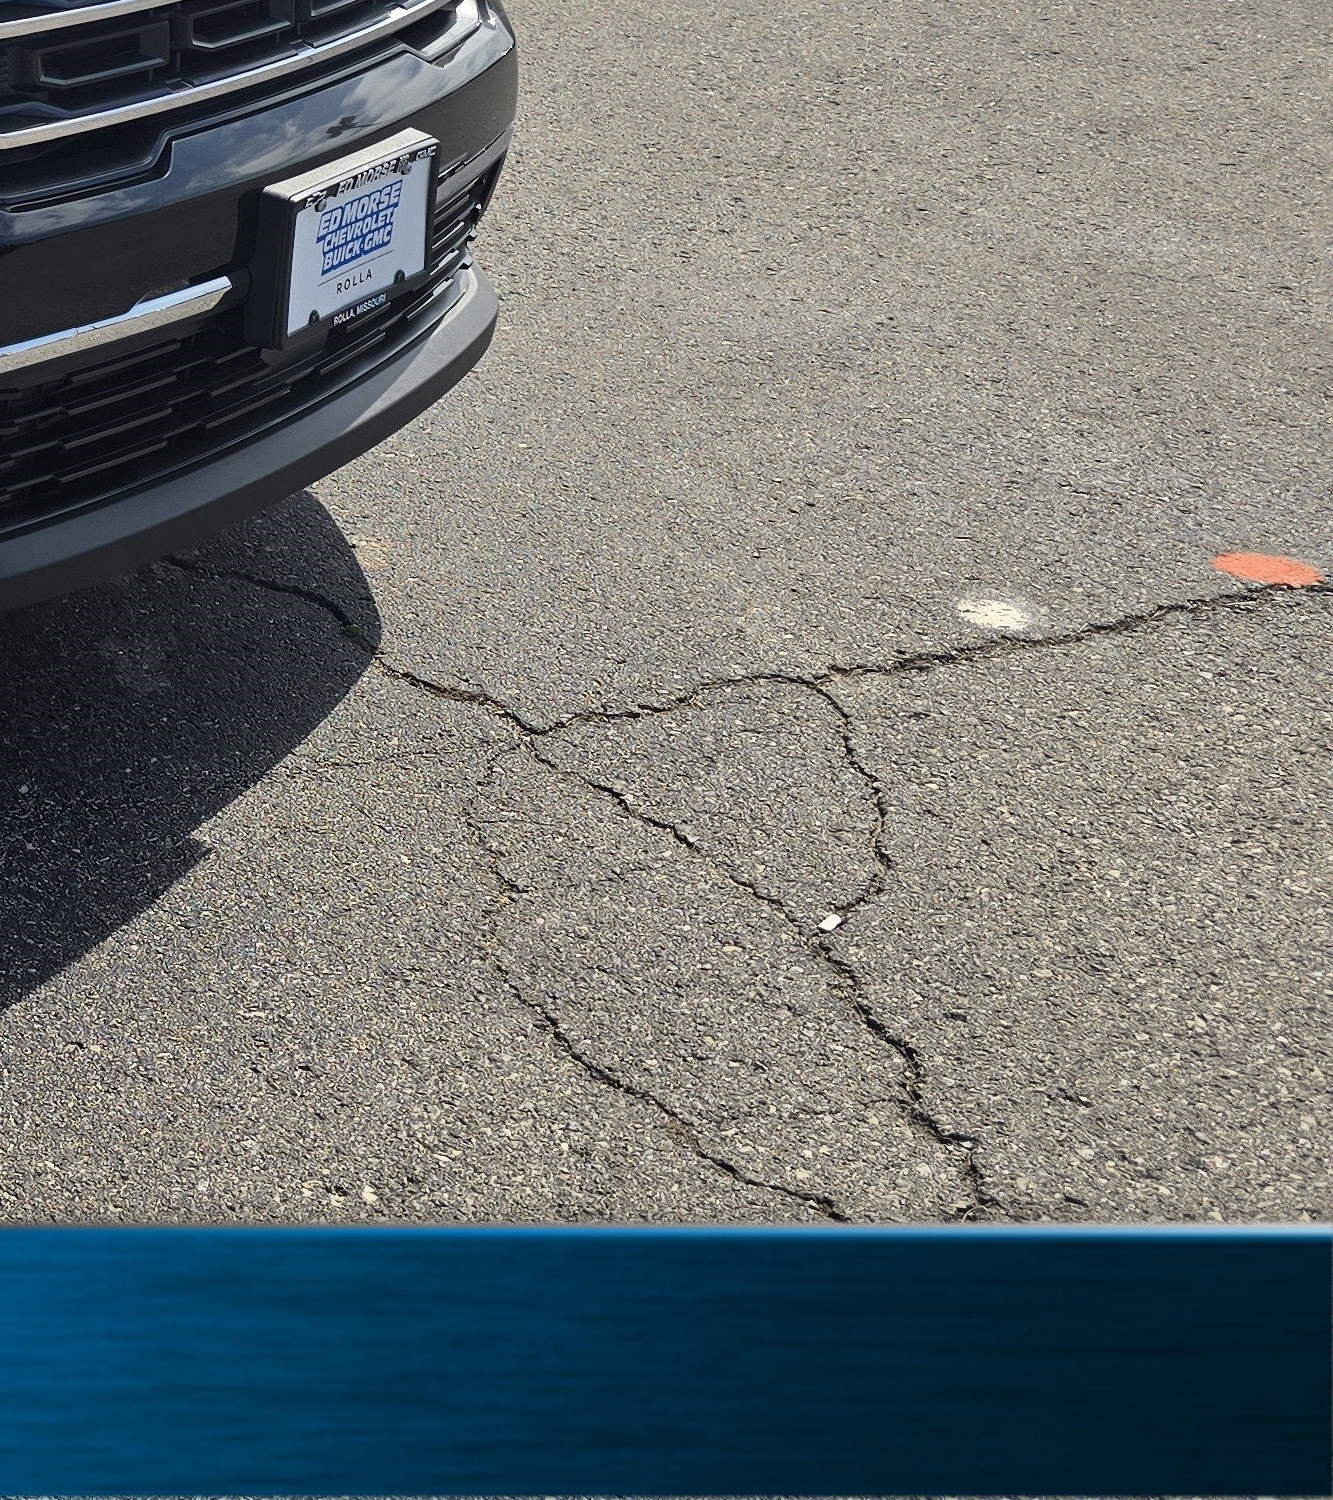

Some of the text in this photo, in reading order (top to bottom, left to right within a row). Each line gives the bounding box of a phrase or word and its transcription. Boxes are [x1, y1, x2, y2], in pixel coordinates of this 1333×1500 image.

[337, 180, 354, 197] ED
[355, 162, 398, 189] MORSE
[318, 184, 401, 237] ED MORSE
[324, 209, 394, 250] CHEVROLET
[336, 268, 373, 294] ROLLA
[334, 293, 387, 327] ROLLA, MISSOURI
